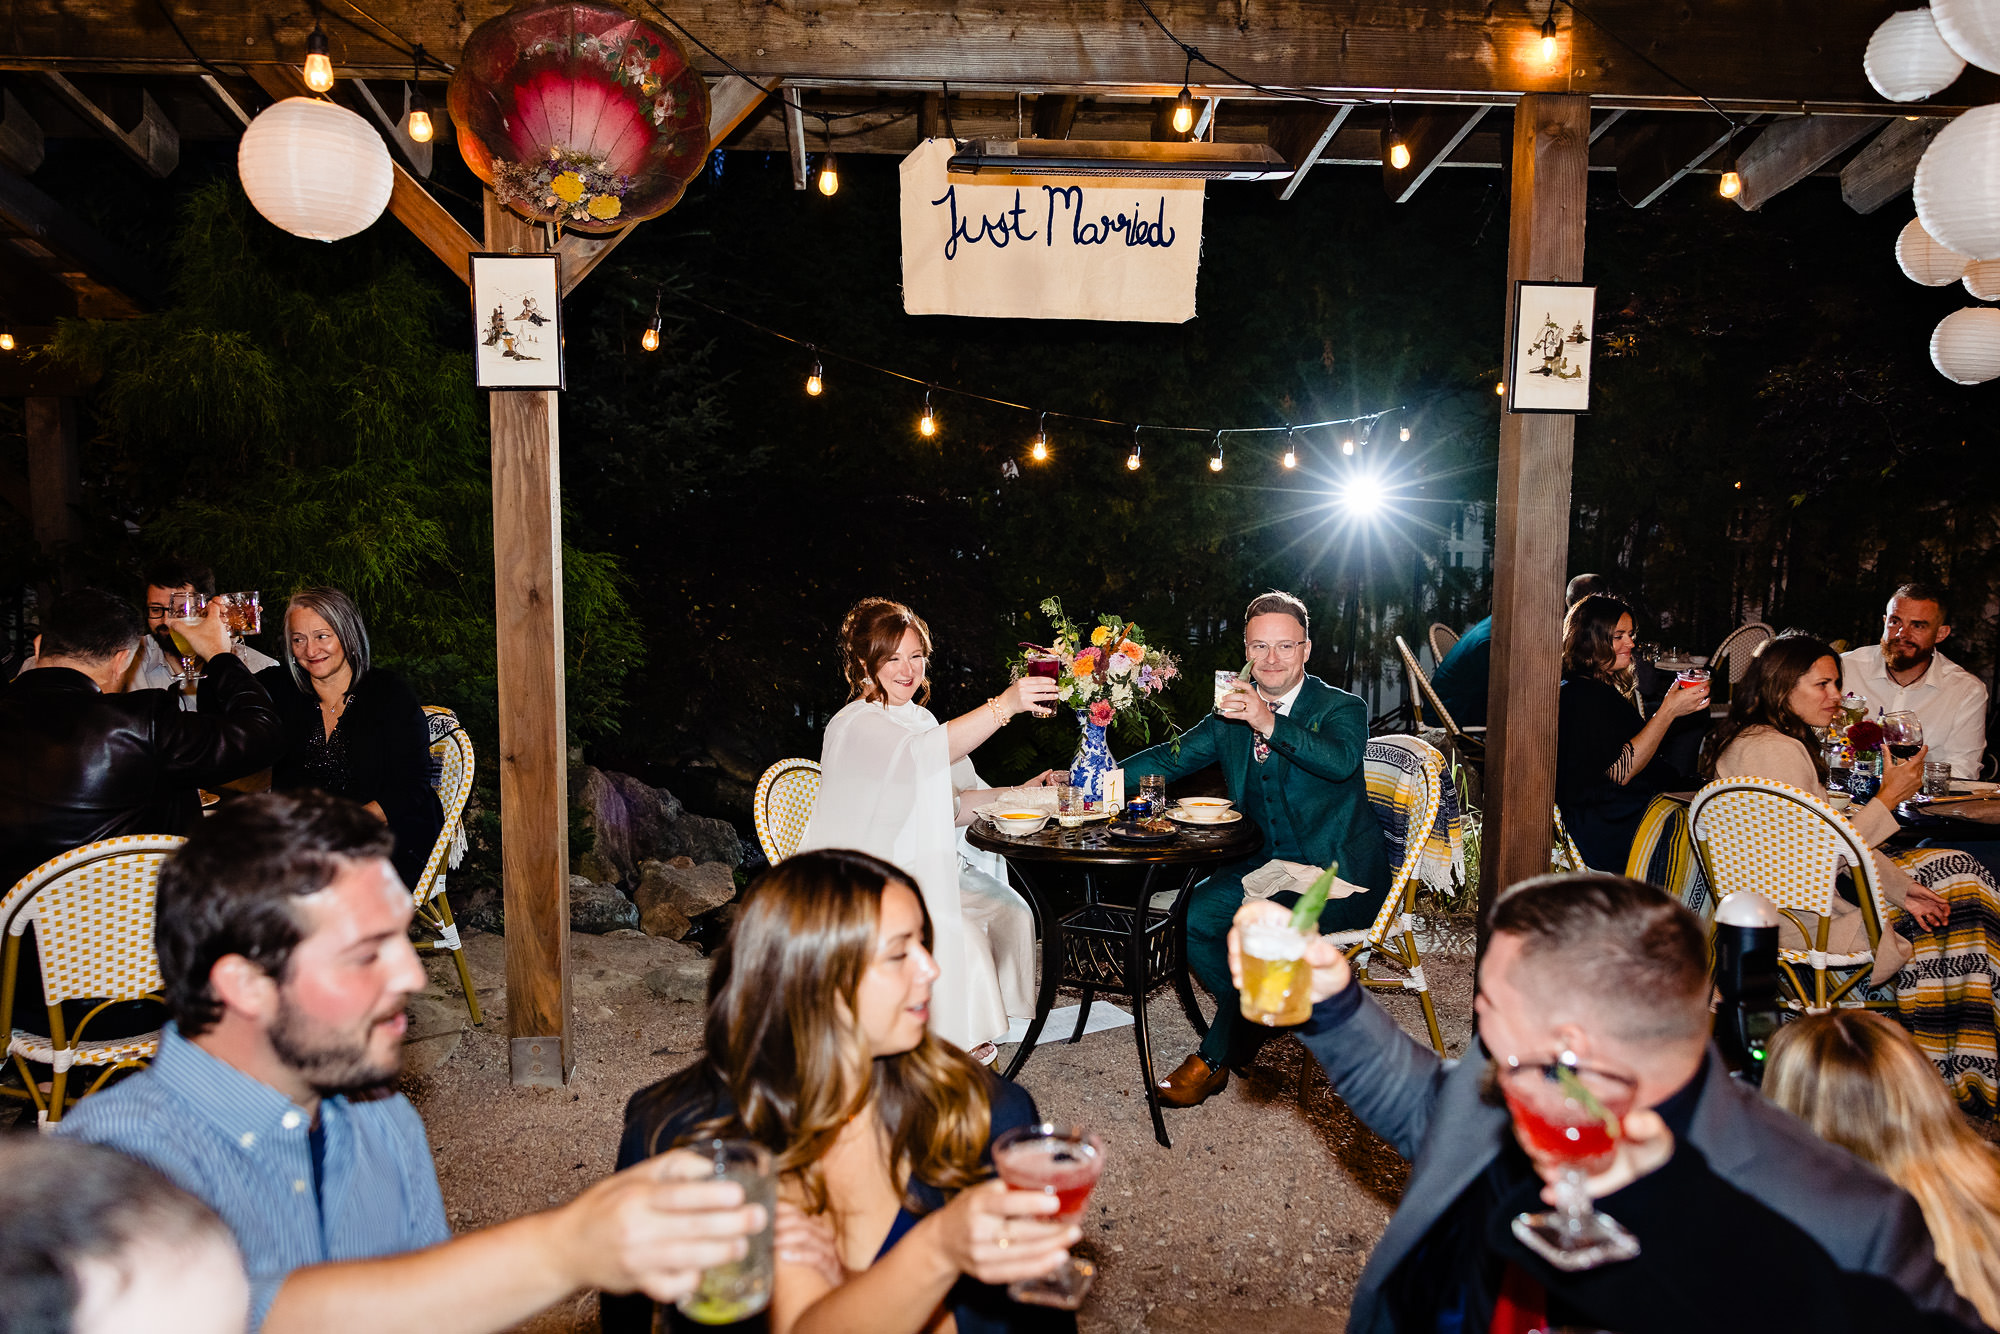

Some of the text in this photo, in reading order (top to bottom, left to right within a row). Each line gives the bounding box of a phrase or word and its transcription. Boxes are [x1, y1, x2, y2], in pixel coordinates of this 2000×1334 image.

[932, 185, 1176, 261] Just Married
[1107, 780, 1119, 803] 1
